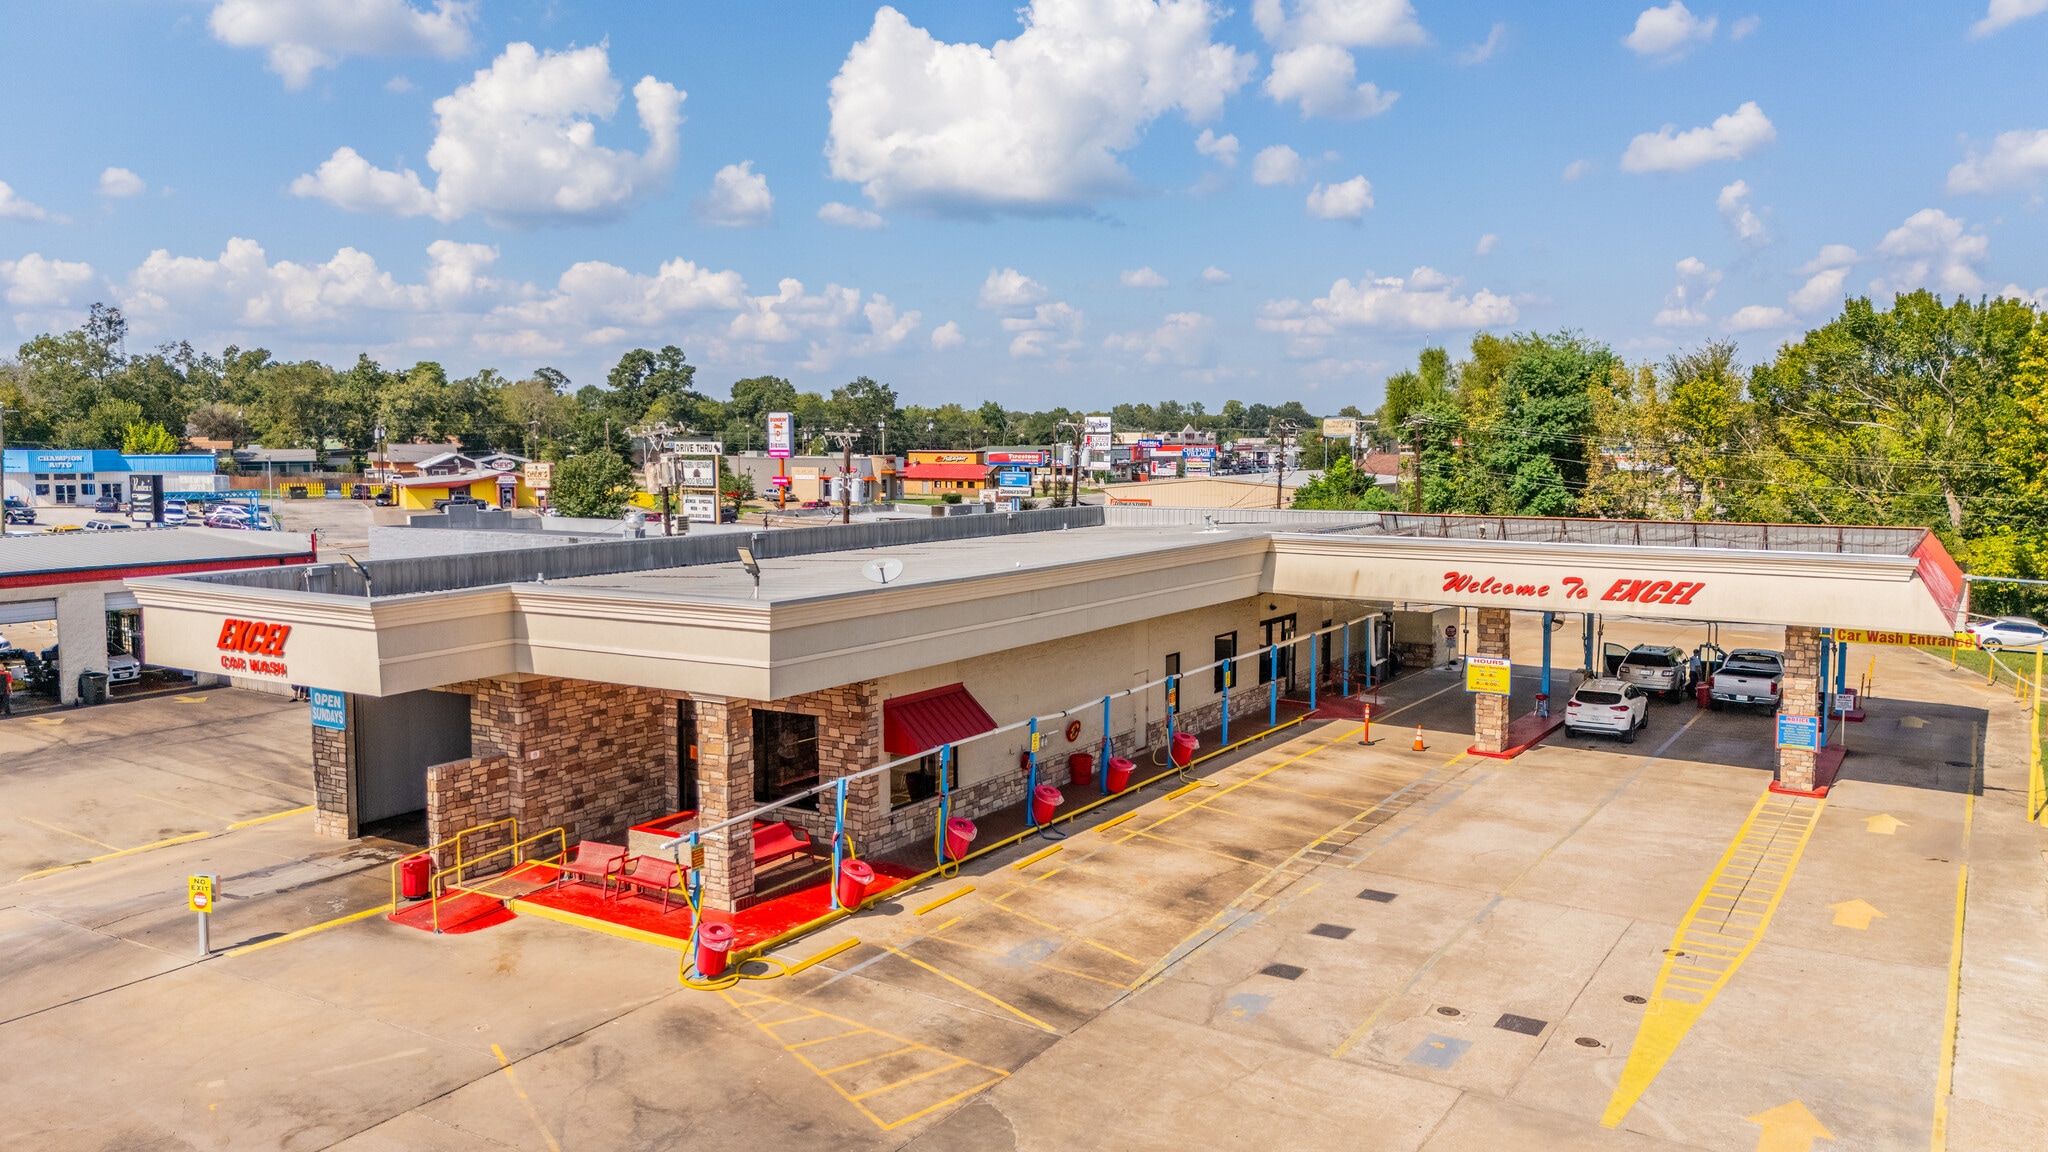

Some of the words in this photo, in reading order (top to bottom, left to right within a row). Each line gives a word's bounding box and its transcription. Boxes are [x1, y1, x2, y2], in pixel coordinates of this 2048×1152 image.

[676, 444, 694, 452] DRIVE
[696, 444, 712, 452] THRU
[1443, 572, 1550, 597] Welcome
[1562, 576, 1588, 599] To
[1600, 579, 1706, 605] EXCEL
[216, 618, 292, 657] EXCEL
[1838, 629, 1862, 642] Car
[1866, 630, 1903, 644] Wash
[1908, 634, 1973, 648] Entrance
[221, 656, 246, 672] CAR
[249, 659, 288, 676] WASH
[314, 692, 341, 708] OPEN
[312, 706, 344, 724] SUNDAYS
